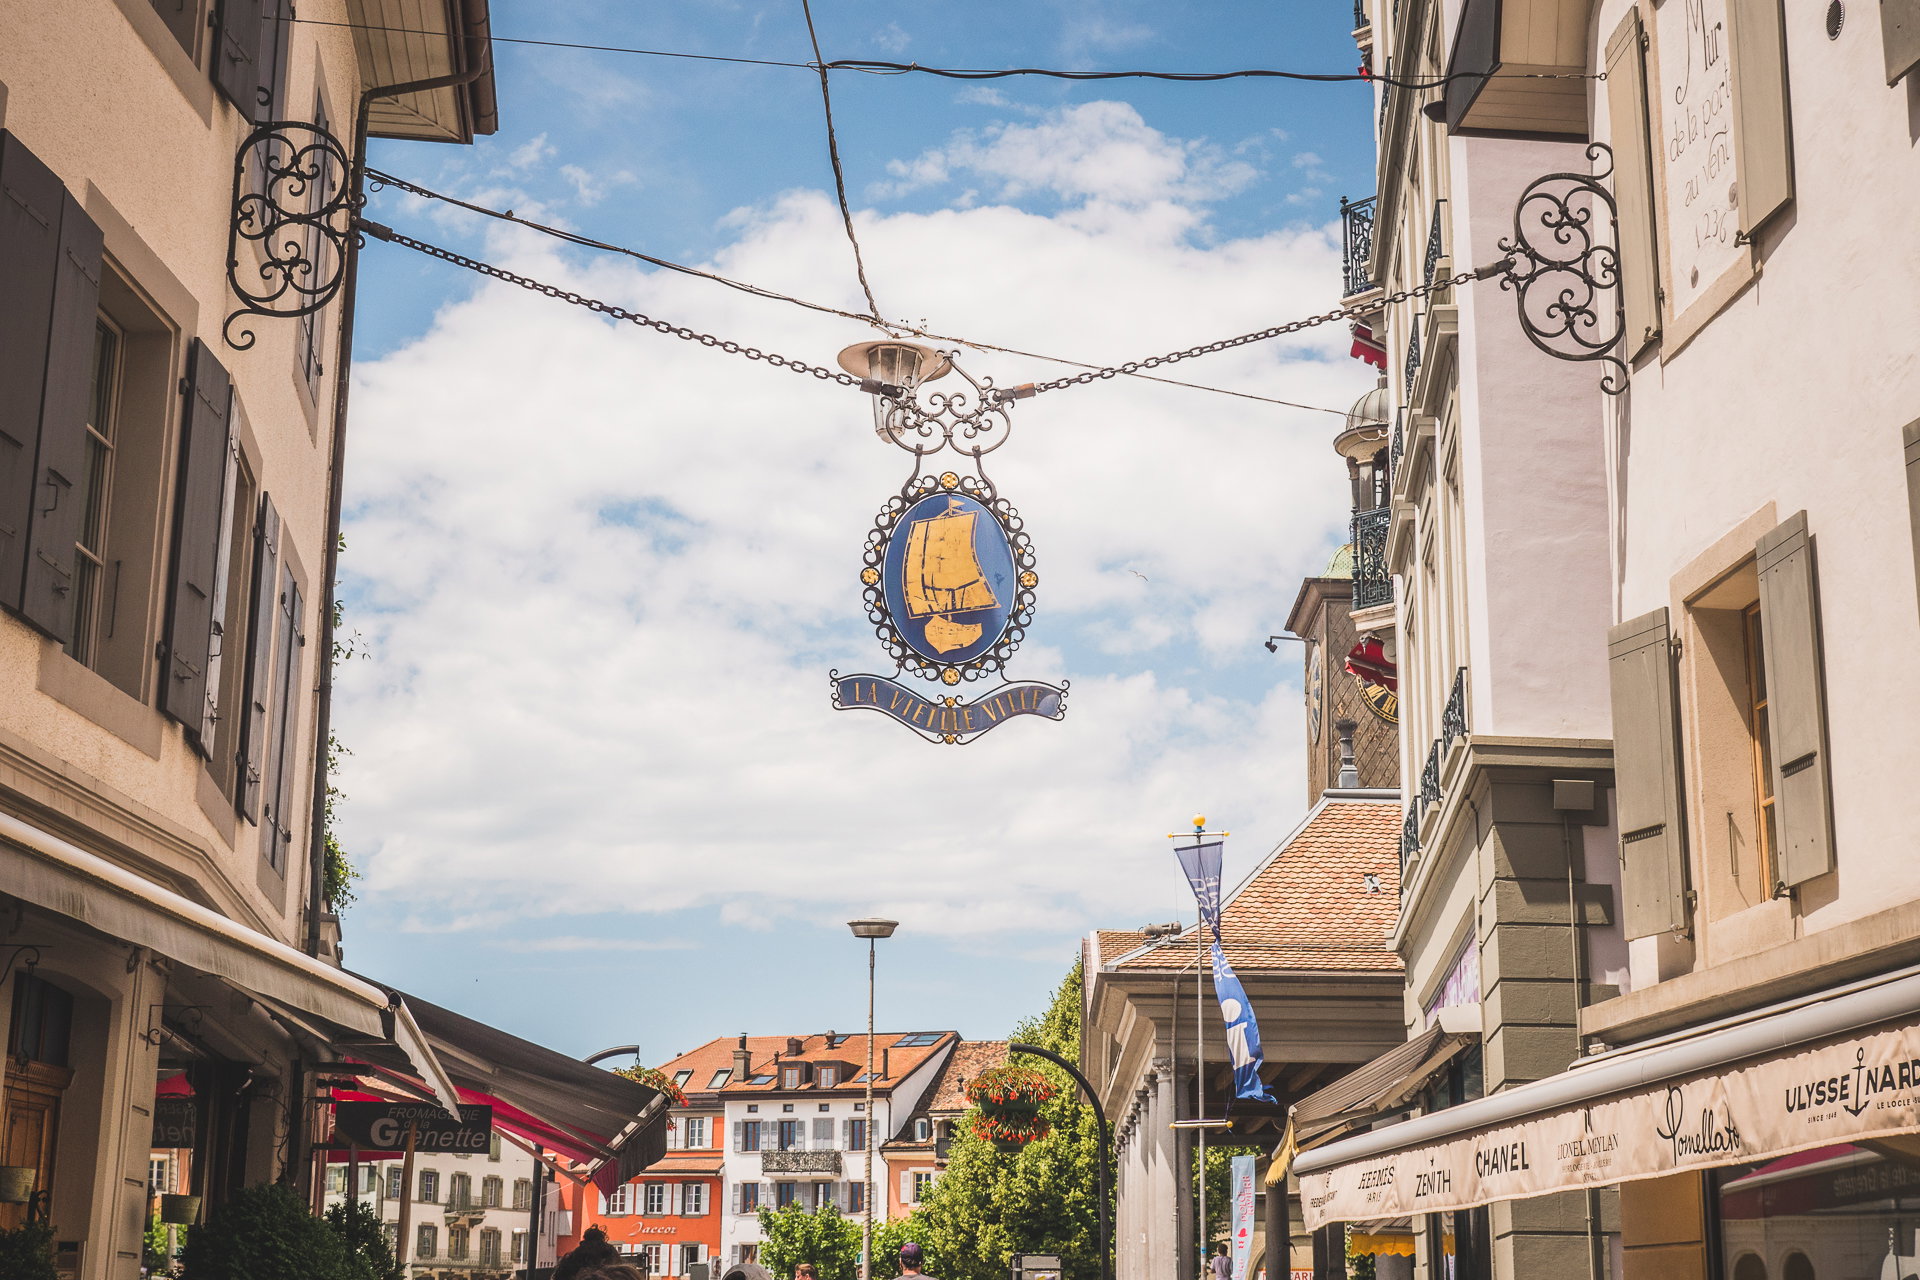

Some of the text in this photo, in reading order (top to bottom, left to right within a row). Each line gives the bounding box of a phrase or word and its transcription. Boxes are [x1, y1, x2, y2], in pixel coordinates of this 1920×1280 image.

[1675, 0, 1722, 105] Mur
[1669, 62, 1732, 162] de la port
[1684, 123, 1731, 208] au vent
[1695, 208, 1727, 249] 1236
[854, 682, 1044, 731] LA VIEILLE VILLE
[1785, 1074, 1850, 1113] ULYSSE
[1877, 1101, 1885, 1110] LE
[1886, 1098, 1911, 1108] LOCLE
[370, 1118, 486, 1148] Grenette
[388, 1107, 480, 1121] FROMAGRIE
[420, 1119, 430, 1129] la
[1657, 1083, 1740, 1165] Pomellato
[1808, 1114, 1824, 1124] SINCE
[1475, 1141, 1529, 1179] CHANEL
[1557, 1132, 1619, 1161] LIONEL MEYLAN
[1415, 1168, 1451, 1199] ZENITH
